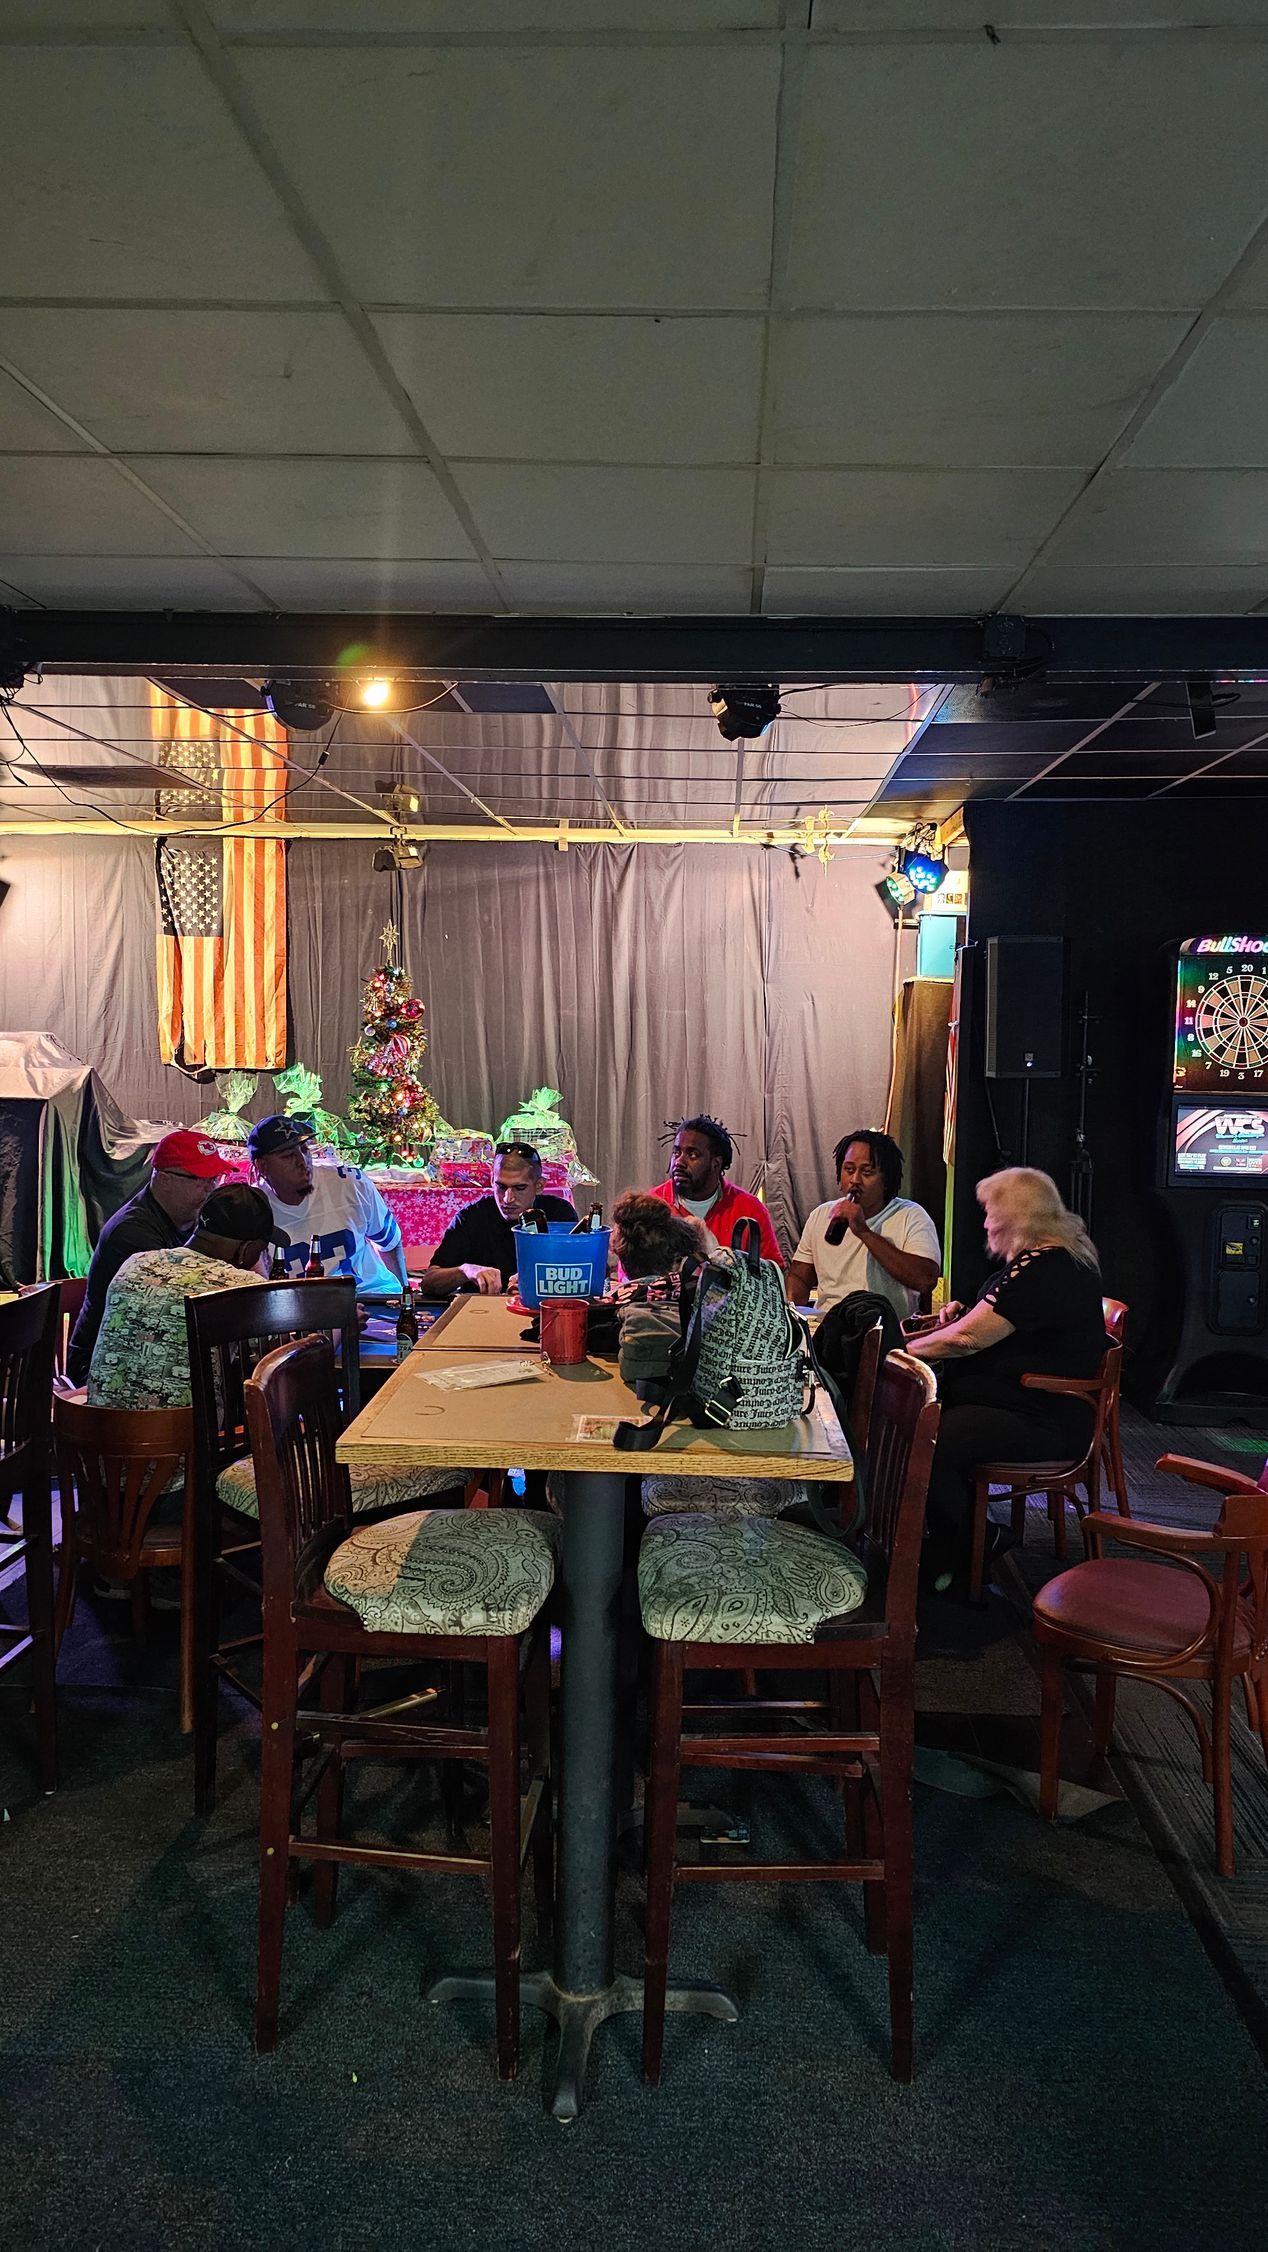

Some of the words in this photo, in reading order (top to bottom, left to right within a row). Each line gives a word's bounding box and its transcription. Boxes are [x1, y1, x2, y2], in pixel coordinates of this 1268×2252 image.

[1226, 966, 1233, 974] 5
[1241, 964, 1254, 972] 20
[1186, 1000, 1196, 1008] 14
[1184, 1017, 1194, 1025] 11
[1191, 1050, 1202, 1058] 16
[1219, 1070, 1230, 1078] 19
[1238, 1072, 1245, 1080] 3
[1215, 1117, 1265, 1134] WCS
[545, 1267, 583, 1281] BUD
[539, 1280, 588, 1294] LIGHT
